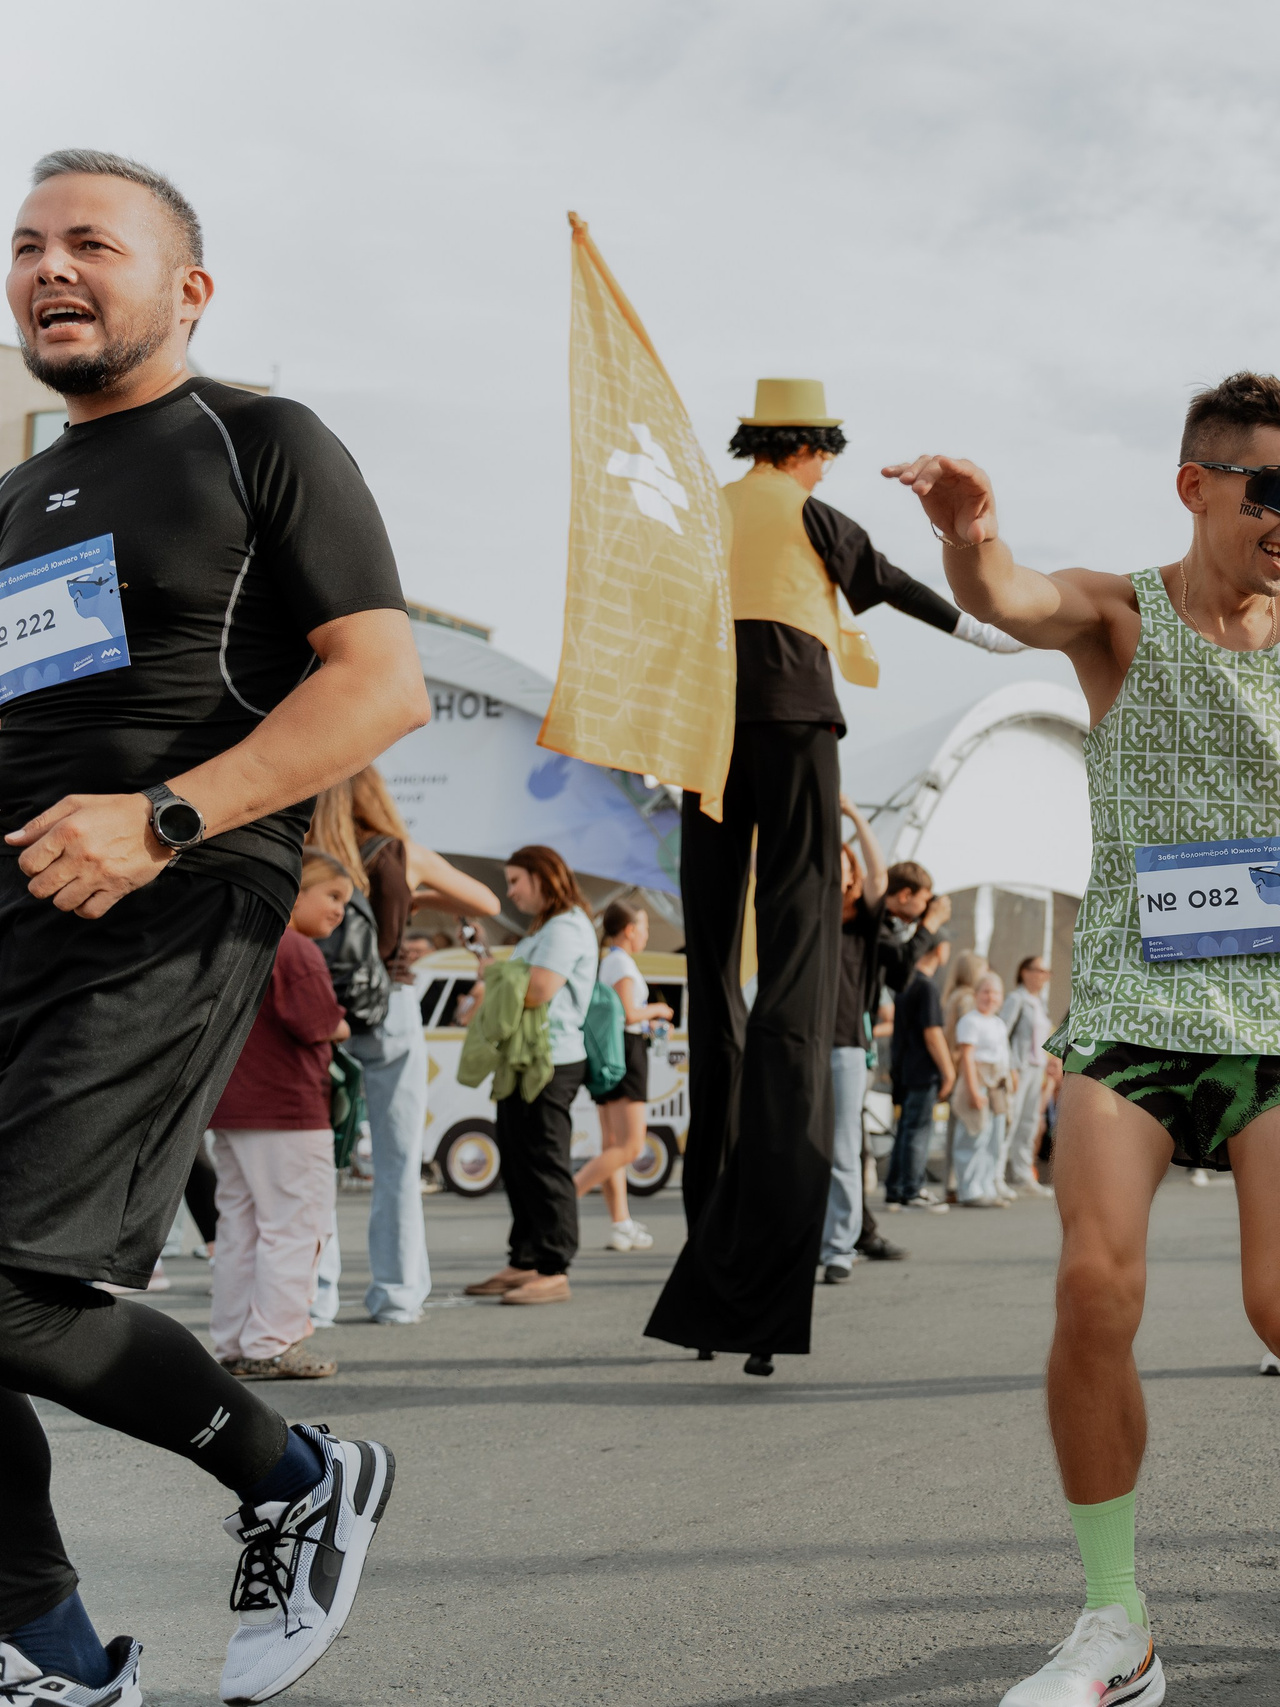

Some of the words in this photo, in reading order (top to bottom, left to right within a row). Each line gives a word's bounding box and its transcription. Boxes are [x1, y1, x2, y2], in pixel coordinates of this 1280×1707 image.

[1240, 503, 1263, 520] TRAIL
[8, 564, 49, 585] волонтёров
[51, 556, 78, 569] Южного
[80, 548, 101, 559] Урала
[16, 609, 56, 640] 222
[1158, 853, 1179, 861] Забег
[1180, 848, 1229, 859] волонтёров
[1231, 847, 1261, 855] Южного
[1188, 887, 1239, 909] 082
[242, 1522, 271, 1539] PUMA
